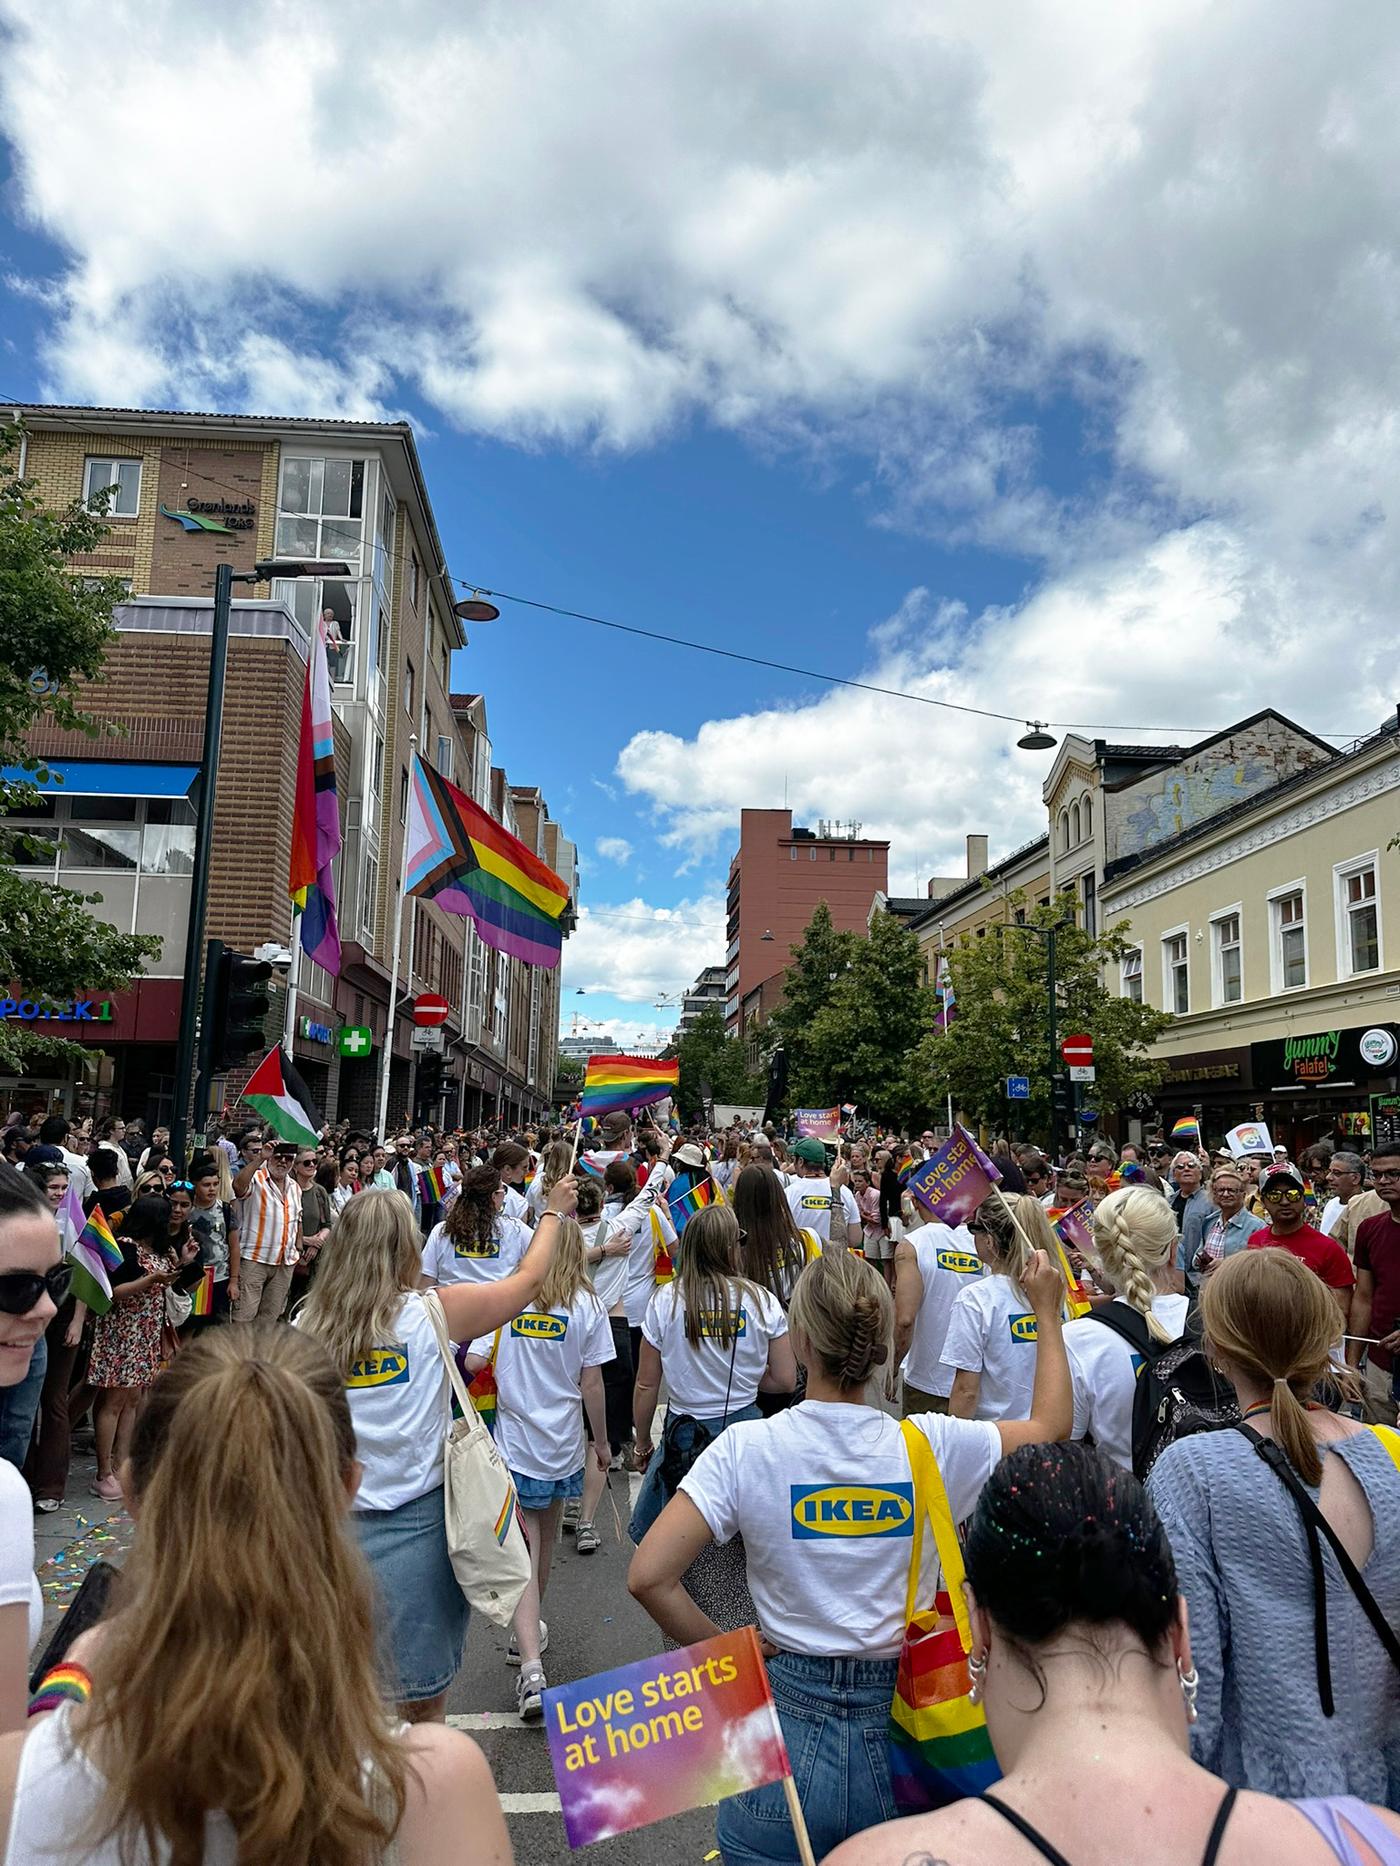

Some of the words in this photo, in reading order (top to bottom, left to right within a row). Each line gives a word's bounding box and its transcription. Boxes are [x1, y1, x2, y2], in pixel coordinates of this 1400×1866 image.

[98, 1000, 113, 1021] 1
[1294, 1056, 1328, 1075] Falafel
[800, 1111, 817, 1119] Love
[915, 1161, 950, 1194] Love
[928, 1187, 946, 1205] at
[942, 1254, 980, 1269] IKEA
[516, 1319, 562, 1332] IKEA
[804, 1499, 906, 1522] IKEA
[556, 1688, 635, 1735] Love
[641, 1655, 738, 1708] starts
[564, 1734, 601, 1772] at
[605, 1705, 703, 1758] home
